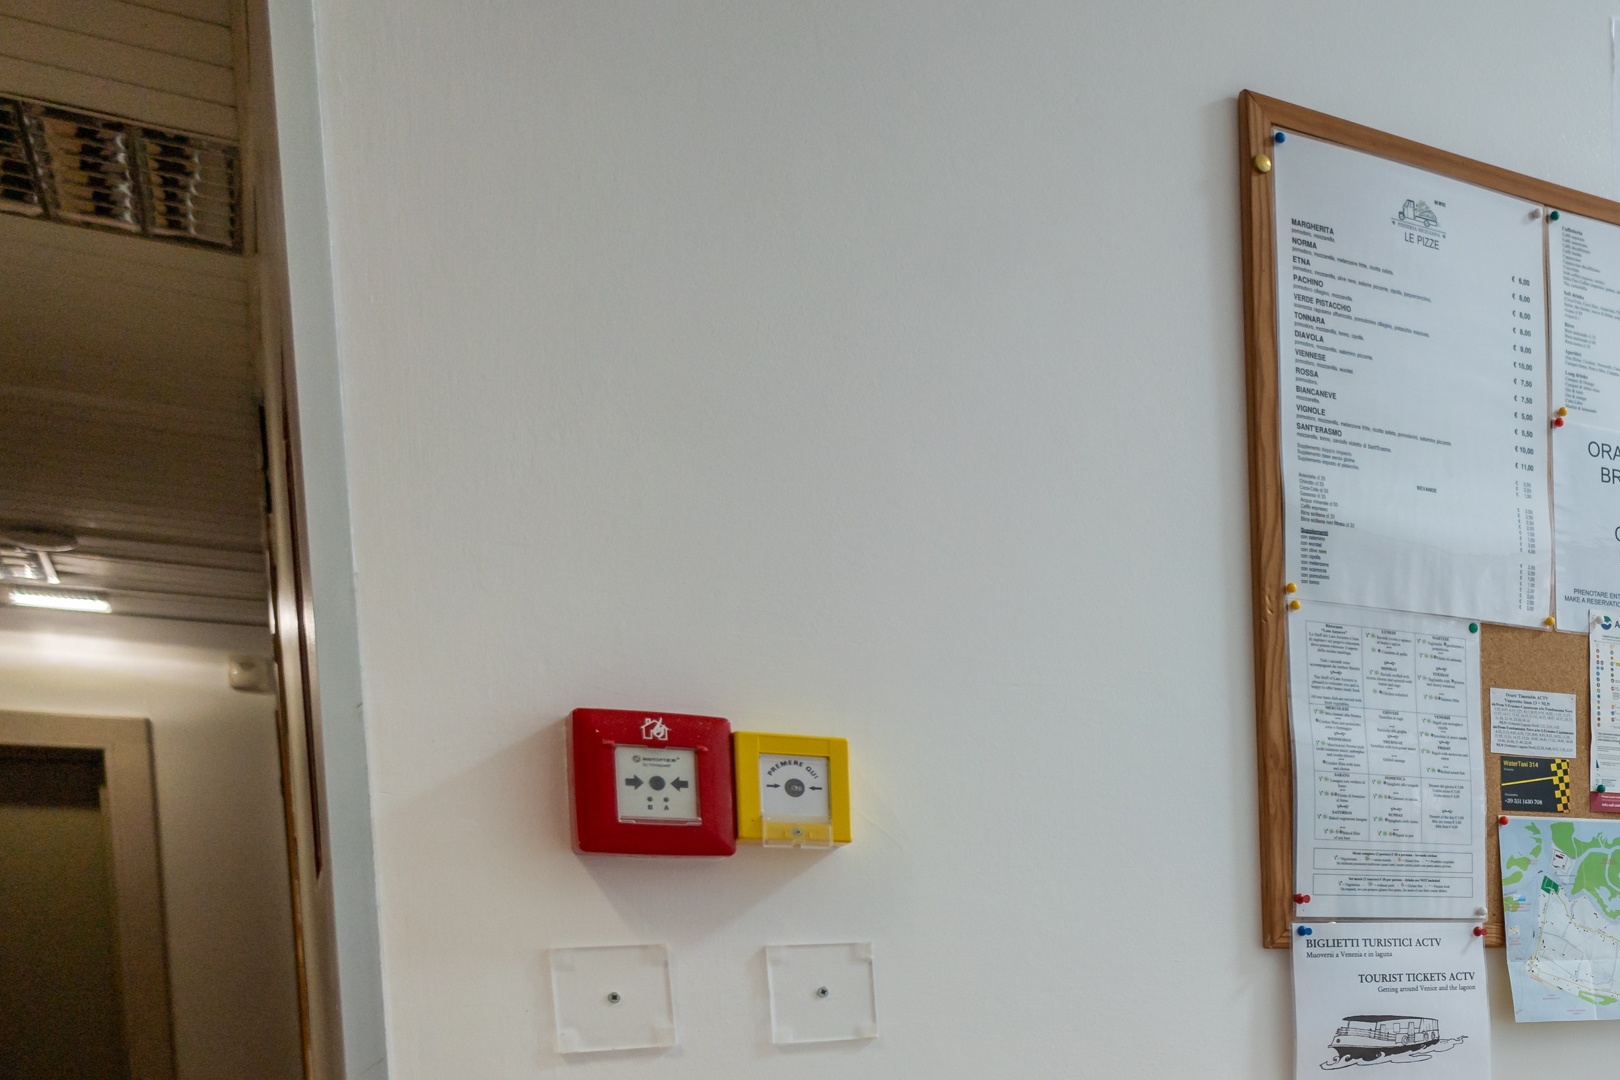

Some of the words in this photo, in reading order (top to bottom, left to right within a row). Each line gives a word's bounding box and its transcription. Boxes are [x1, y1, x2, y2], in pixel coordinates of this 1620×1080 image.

[1291, 218, 1335, 235] MARGHERITA
[1292, 237, 1317, 250] NORMA
[1404, 232, 1415, 243] LE
[1417, 235, 1440, 250] PIZZE
[1292, 256, 1311, 266] ETNA
[1293, 274, 1323, 287] PACHINO
[1294, 293, 1314, 305] VERDE
[1316, 297, 1351, 313] PISTACCHIO
[1294, 312, 1325, 325] TONNARA
[1294, 330, 1324, 343] DIAVOLA
[1295, 349, 1326, 362] VIENNESE
[1296, 367, 1319, 378] ROSSA
[1296, 385, 1336, 400] BIANCANEVE
[1296, 404, 1326, 416] VIGNOLE
[1296, 422, 1342, 437] SANT'ERASMO
[767, 760, 804, 776] PREMERE
[805, 766, 819, 779] QUI
[1503, 760, 1528, 768] WaterTaxi
[1306, 938, 1359, 949] BIGLIETTI
[1362, 937, 1412, 948] TURISTICI
[1415, 937, 1441, 947] ACTV
[1306, 951, 1333, 959] Muoversi
[1358, 973, 1403, 984] TOURIST
[1406, 972, 1447, 983] TICKETS
[1449, 972, 1475, 981] ACTV
